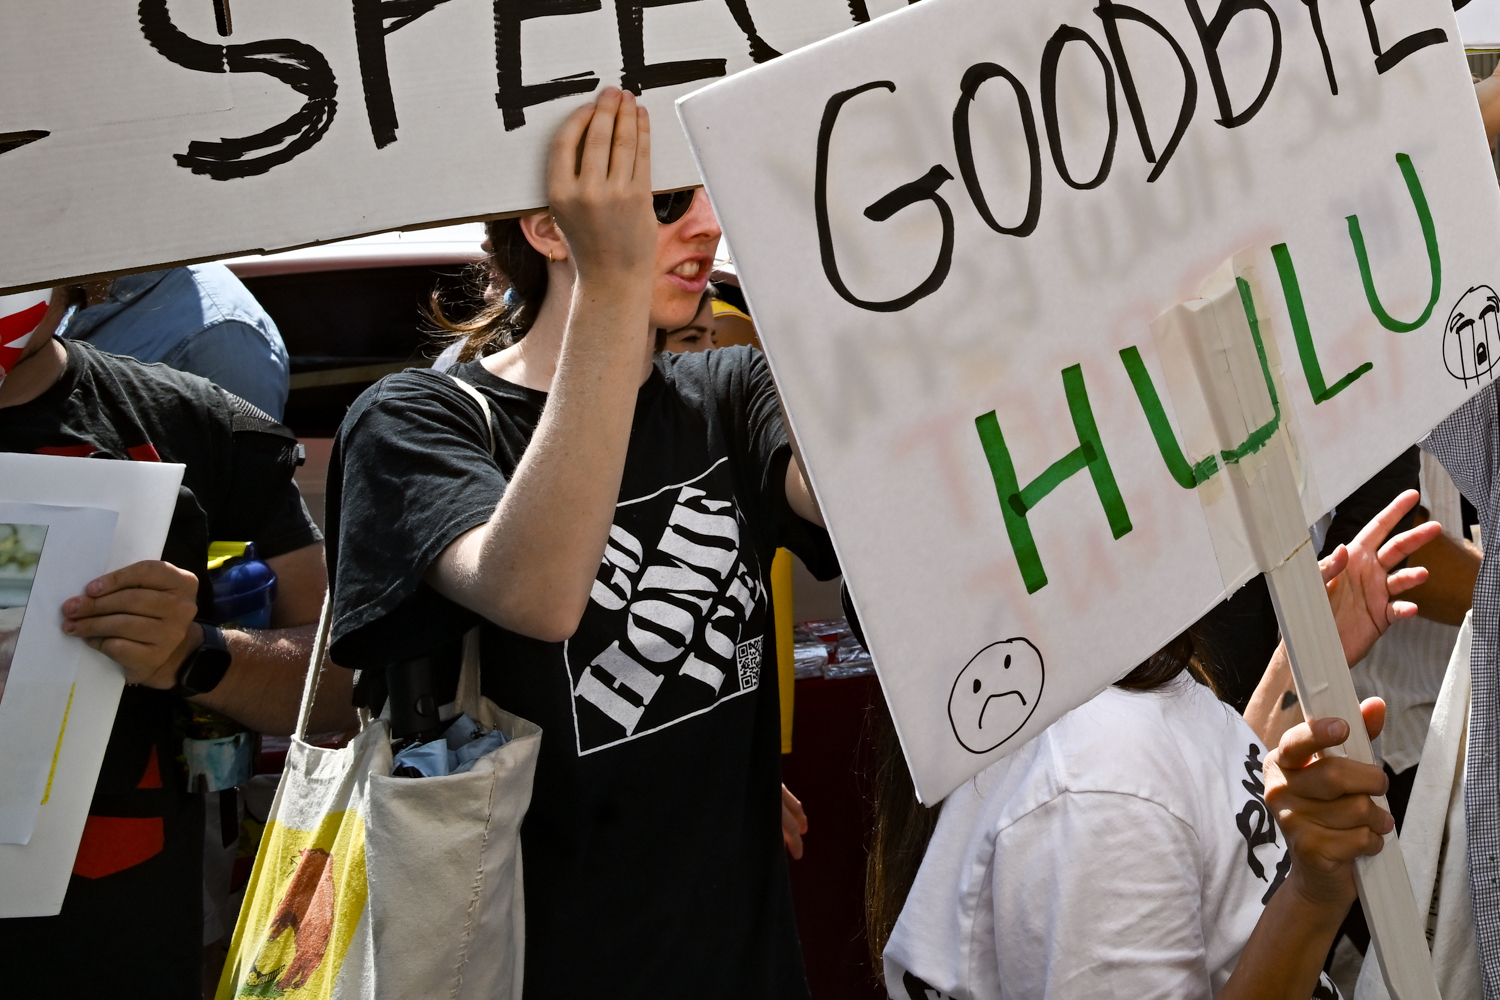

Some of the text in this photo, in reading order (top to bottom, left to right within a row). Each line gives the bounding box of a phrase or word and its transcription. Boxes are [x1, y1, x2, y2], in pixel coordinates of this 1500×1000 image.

[975, 152, 1442, 596] HULU
[574, 485, 740, 737] HOME
[679, 561, 761, 697] ICE
